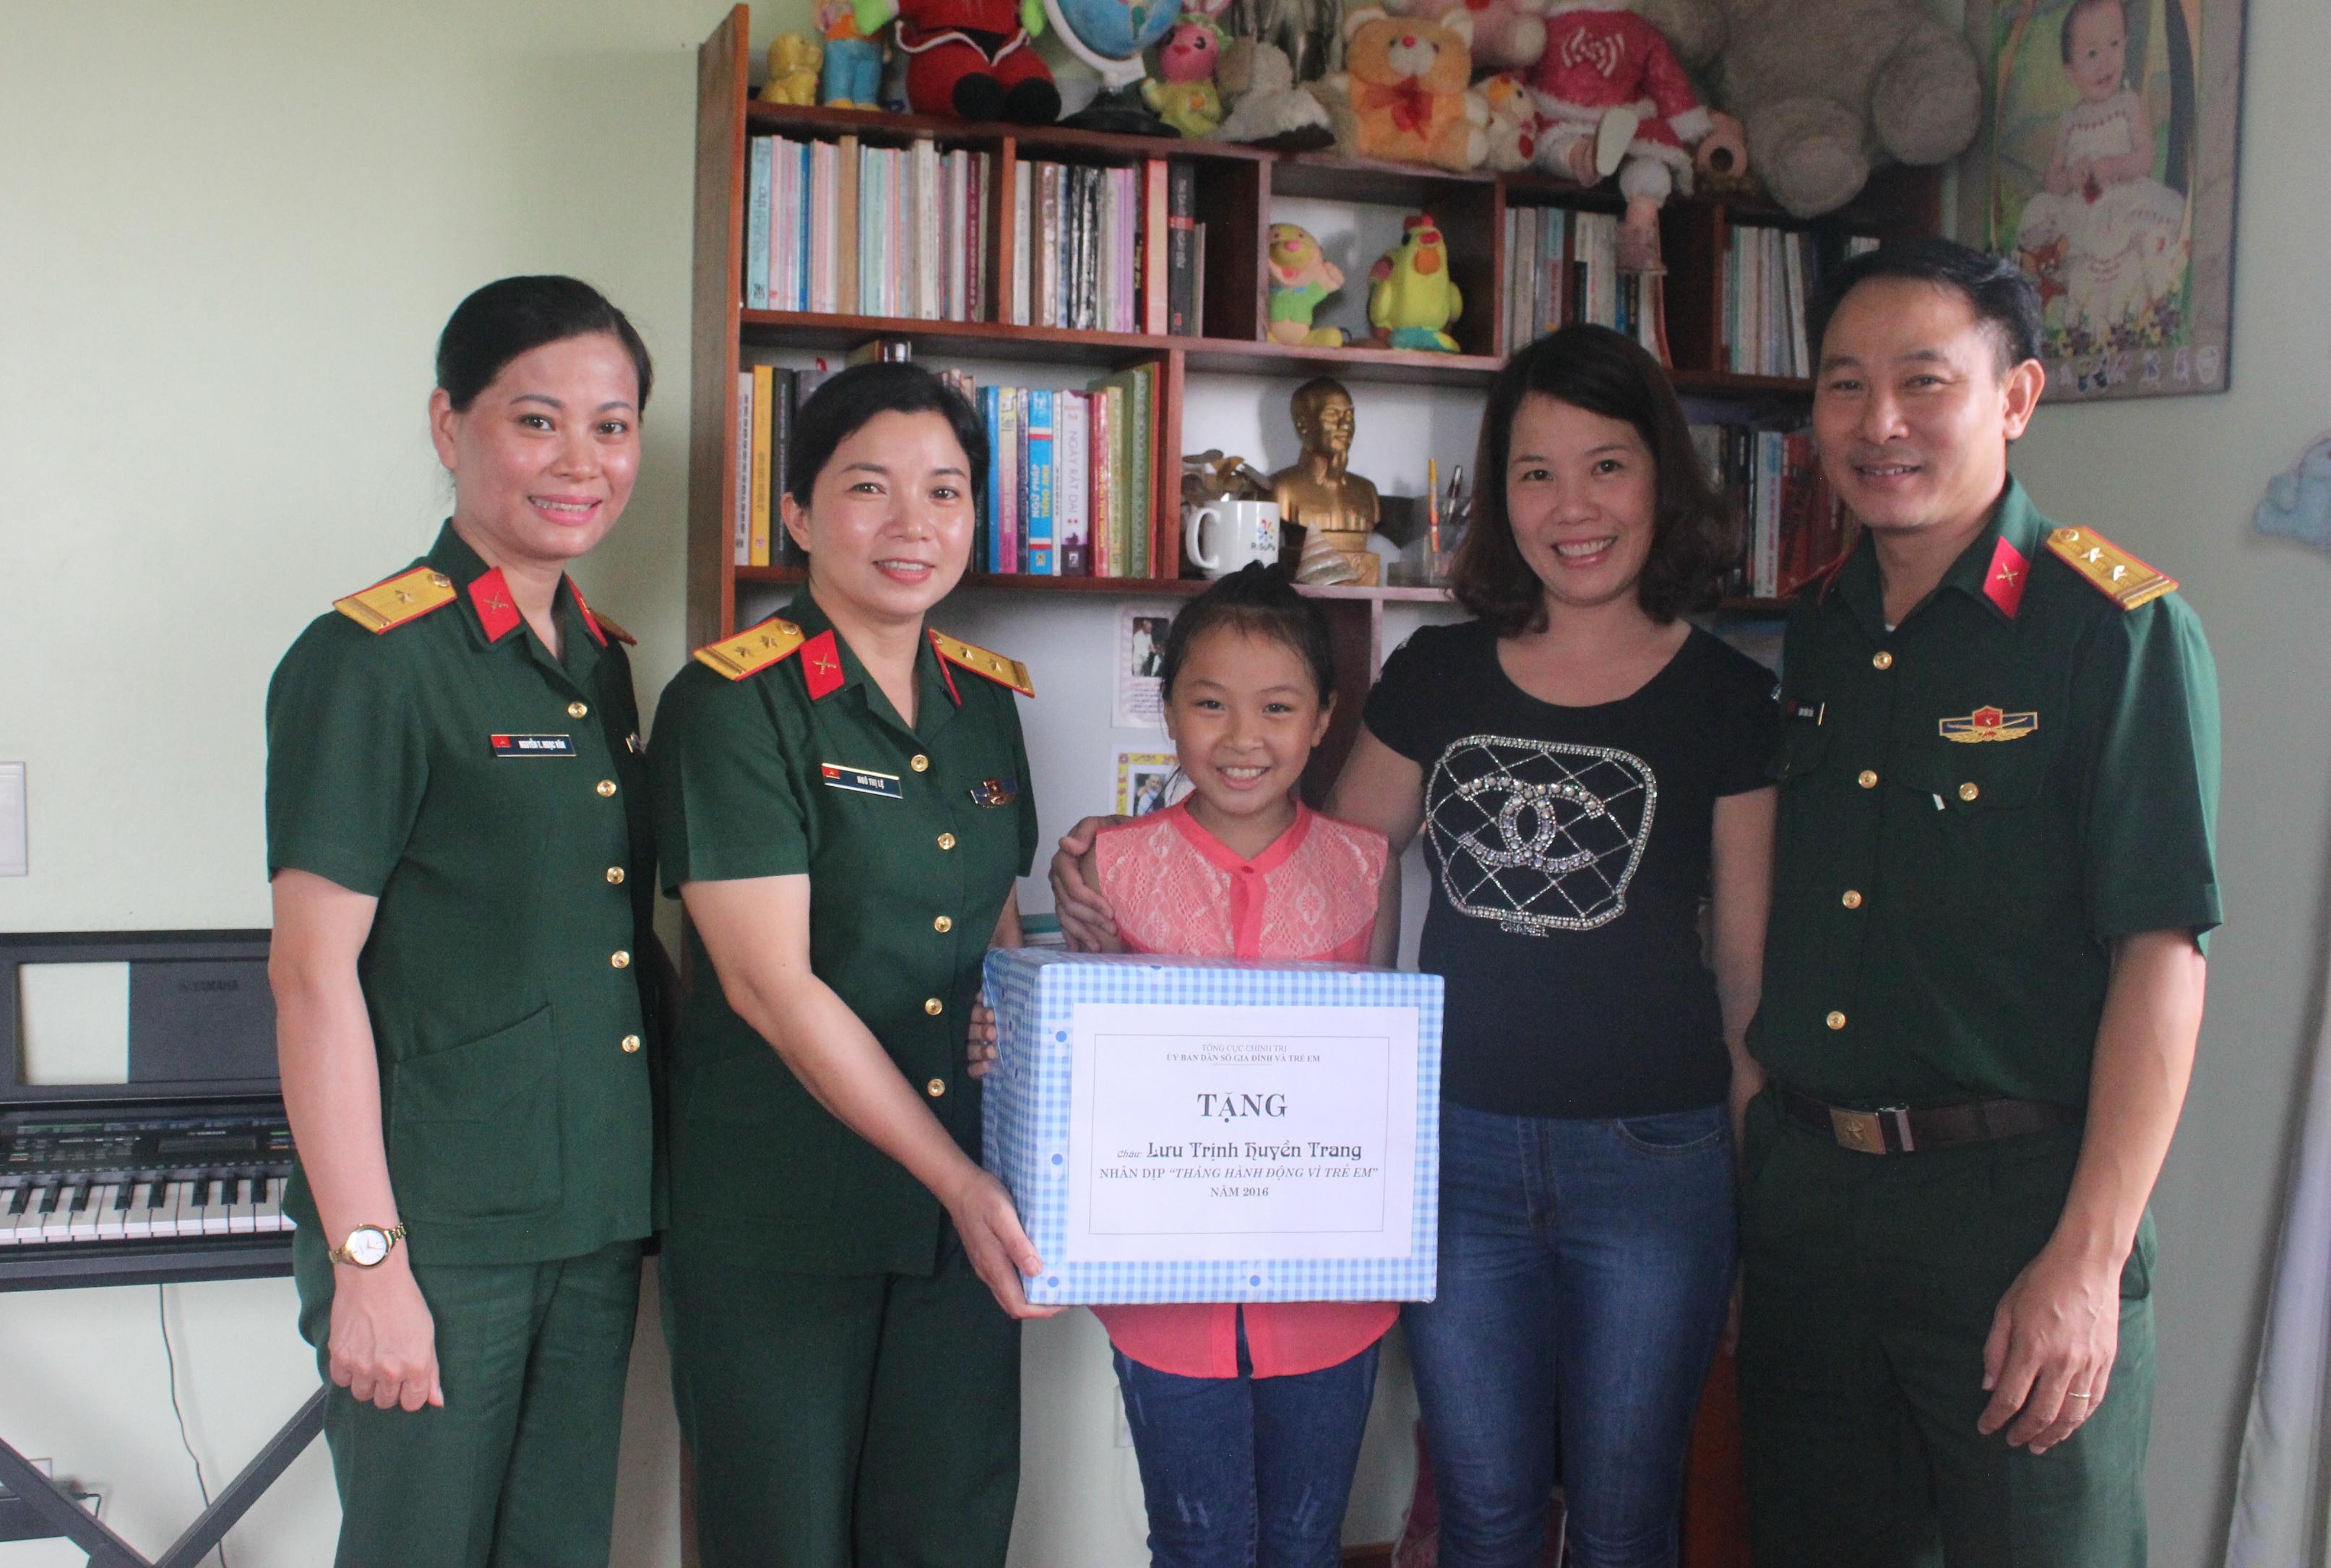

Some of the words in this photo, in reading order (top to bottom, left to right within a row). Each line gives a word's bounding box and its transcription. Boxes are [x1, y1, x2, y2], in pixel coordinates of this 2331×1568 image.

[1202, 1043, 1225, 1052] TỔNG
[1225, 1045, 1244, 1054] CỤC
[1245, 1043, 1272, 1052] CHÍNH
[1200, 1053, 1219, 1061] DÂN
[1251, 1053, 1272, 1062] ĐÌNH
[1275, 1054, 1288, 1062] VÀ
[1197, 1091, 1288, 1123] TẶNG
[1147, 1142, 1184, 1158] Lưu
[1189, 1142, 1238, 1162] Trịnh
[1244, 1140, 1302, 1162] Huyền
[1307, 1142, 1362, 1161] Trang
[1099, 1165, 1138, 1179] NHÂN
[1142, 1168, 1166, 1181] DỊP
[1223, 1165, 1264, 1179] HÀNH
[1265, 1165, 1304, 1181] ĐỘNG
[1308, 1165, 1322, 1179] VÌ
[1324, 1163, 1350, 1179] TRẺ
[1210, 1184, 1239, 1197] NĂM
[1242, 1186, 1270, 1197] 2016
